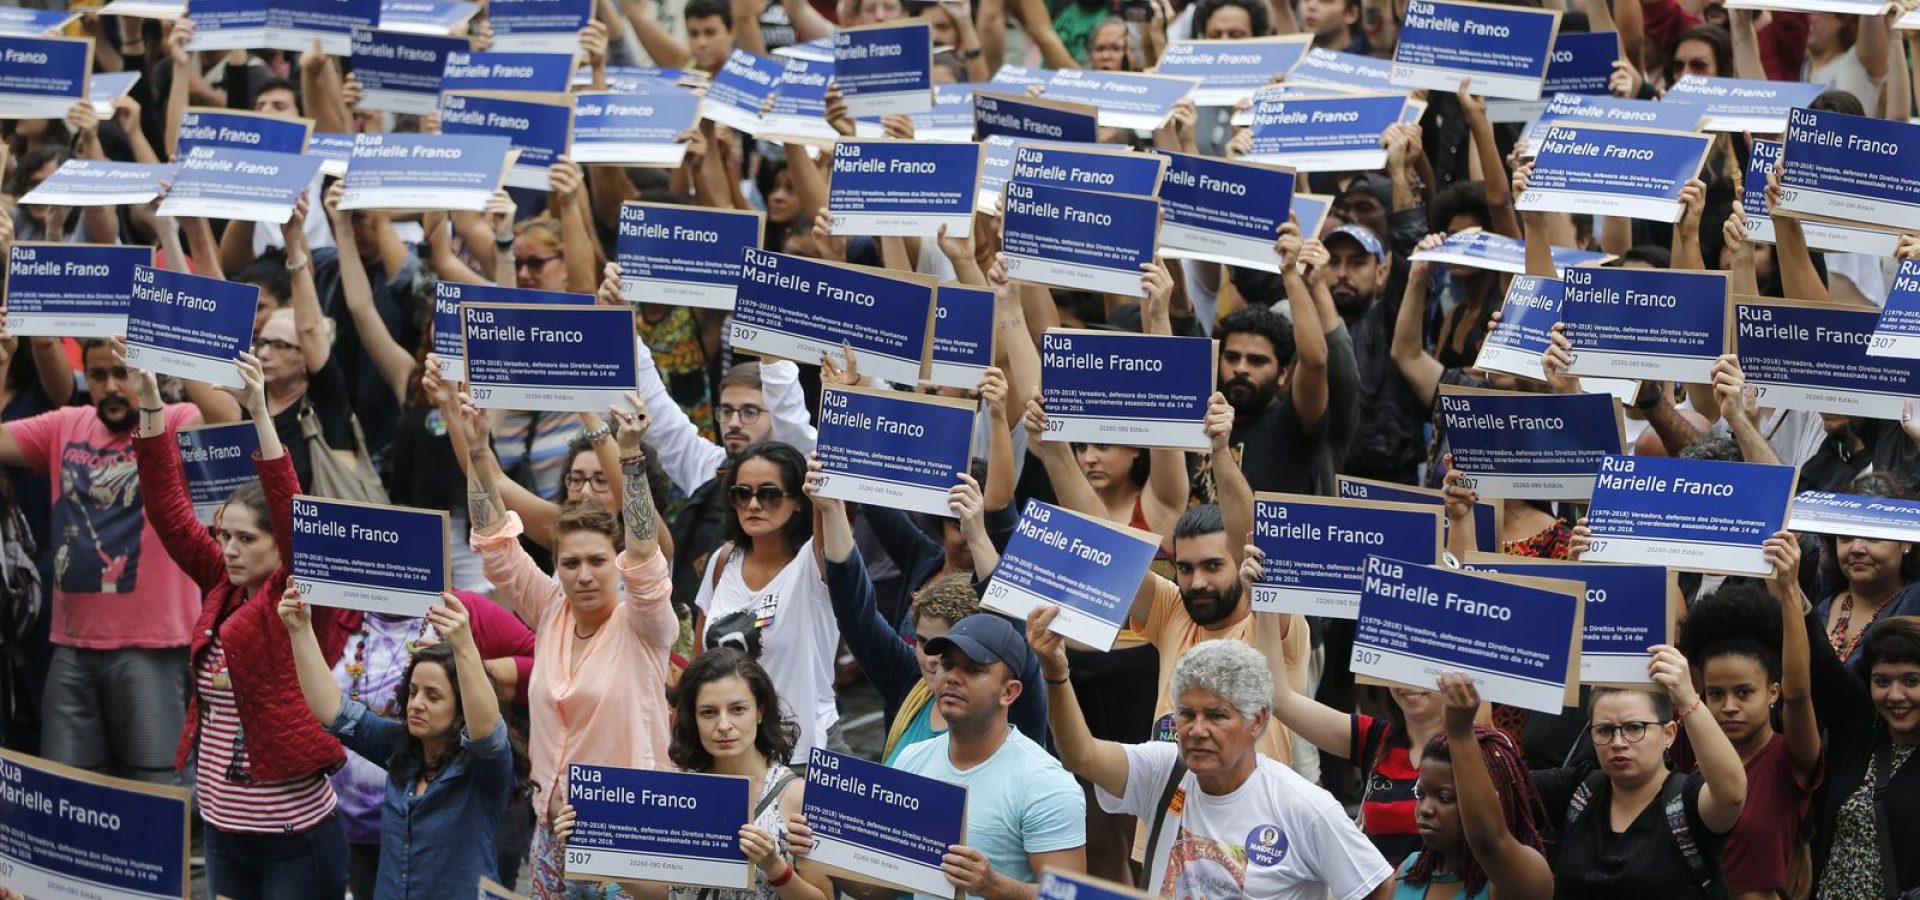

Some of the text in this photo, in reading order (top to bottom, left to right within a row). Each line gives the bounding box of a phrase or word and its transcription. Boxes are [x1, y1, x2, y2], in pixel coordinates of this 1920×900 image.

[1409, 0, 1434, 15] Rua
[1406, 14, 1510, 38] Marielle Franco
[1258, 102, 1284, 113] Rua
[1553, 93, 1580, 105] Rua
[1254, 112, 1359, 125] Marielle Franco
[1547, 105, 1659, 121] Marielle Franco
[1791, 109, 1817, 126] Rua
[356, 135, 383, 146] Rua
[1548, 126, 1577, 140] Rua
[1789, 126, 1898, 155] Marielle Franco
[190, 146, 214, 159] Rua
[353, 146, 461, 159] Marielle Franco
[836, 142, 860, 157] Rua
[1018, 148, 1042, 163] Rua
[1542, 141, 1654, 160] Marielle Franco
[184, 158, 278, 176] Marielle Franco
[834, 159, 936, 173] Marielle Franco
[1016, 164, 1115, 185] Marielle Franco
[1164, 165, 1245, 195] rielle Franco
[1008, 182, 1033, 199] Rua
[621, 207, 644, 221] Rua
[1007, 198, 1111, 226] Marielle Franco
[619, 221, 717, 242] Marielle Franco
[12, 246, 35, 260] Rua
[745, 248, 777, 268] Rua
[11, 262, 109, 276] Marielle Franco
[134, 266, 154, 284] Rua
[1566, 269, 1592, 285] Rua
[743, 265, 875, 307] Marielle Franco
[1513, 275, 1536, 291] Rua
[132, 284, 215, 312] Marielle Franco
[1507, 291, 1552, 310] Marielle
[1564, 287, 1676, 307] Marielle Franco
[467, 308, 494, 323] Rua
[1739, 303, 1772, 321] Rua
[468, 326, 582, 343] Marielle Franco
[734, 327, 758, 341] 307
[1740, 322, 1809, 341] Marielle
[1044, 334, 1072, 350] Rua
[1872, 337, 1896, 349] 307
[1044, 352, 1162, 372] Marielle Franco
[473, 388, 492, 400] 307
[824, 390, 848, 408] Rua
[1442, 397, 1471, 412] Rua
[821, 408, 923, 437] Marielle Franco
[1445, 414, 1563, 429] Marielle Franco
[210, 445, 240, 460] Franco
[1602, 455, 1635, 472] Rua
[1341, 481, 1368, 498] Rua
[1459, 478, 1478, 489] 307
[1598, 474, 1734, 497] Marielle Franco
[1794, 496, 1862, 508] Marielle
[1800, 490, 1836, 498] Rua
[293, 500, 318, 517] Rua
[1025, 499, 1051, 523] Rua
[1257, 501, 1287, 519] Rua
[293, 517, 399, 544] Marielle Franco
[1257, 520, 1385, 545] Marielle Franco
[1017, 518, 1112, 567] Marielle Franco
[1368, 556, 1403, 579] Rua
[989, 585, 1009, 600] 307
[1255, 590, 1277, 603] 307
[1366, 577, 1510, 621] Marielle Franco
[1616, 626, 1648, 634] Humanos
[1355, 650, 1381, 666] 307
[812, 747, 839, 770] Rua
[572, 764, 602, 782] Rua
[571, 783, 697, 810] Marielle Franco
[809, 766, 920, 811] Marielle Franco
[59, 798, 120, 831] Franco
[569, 852, 592, 865] 307
